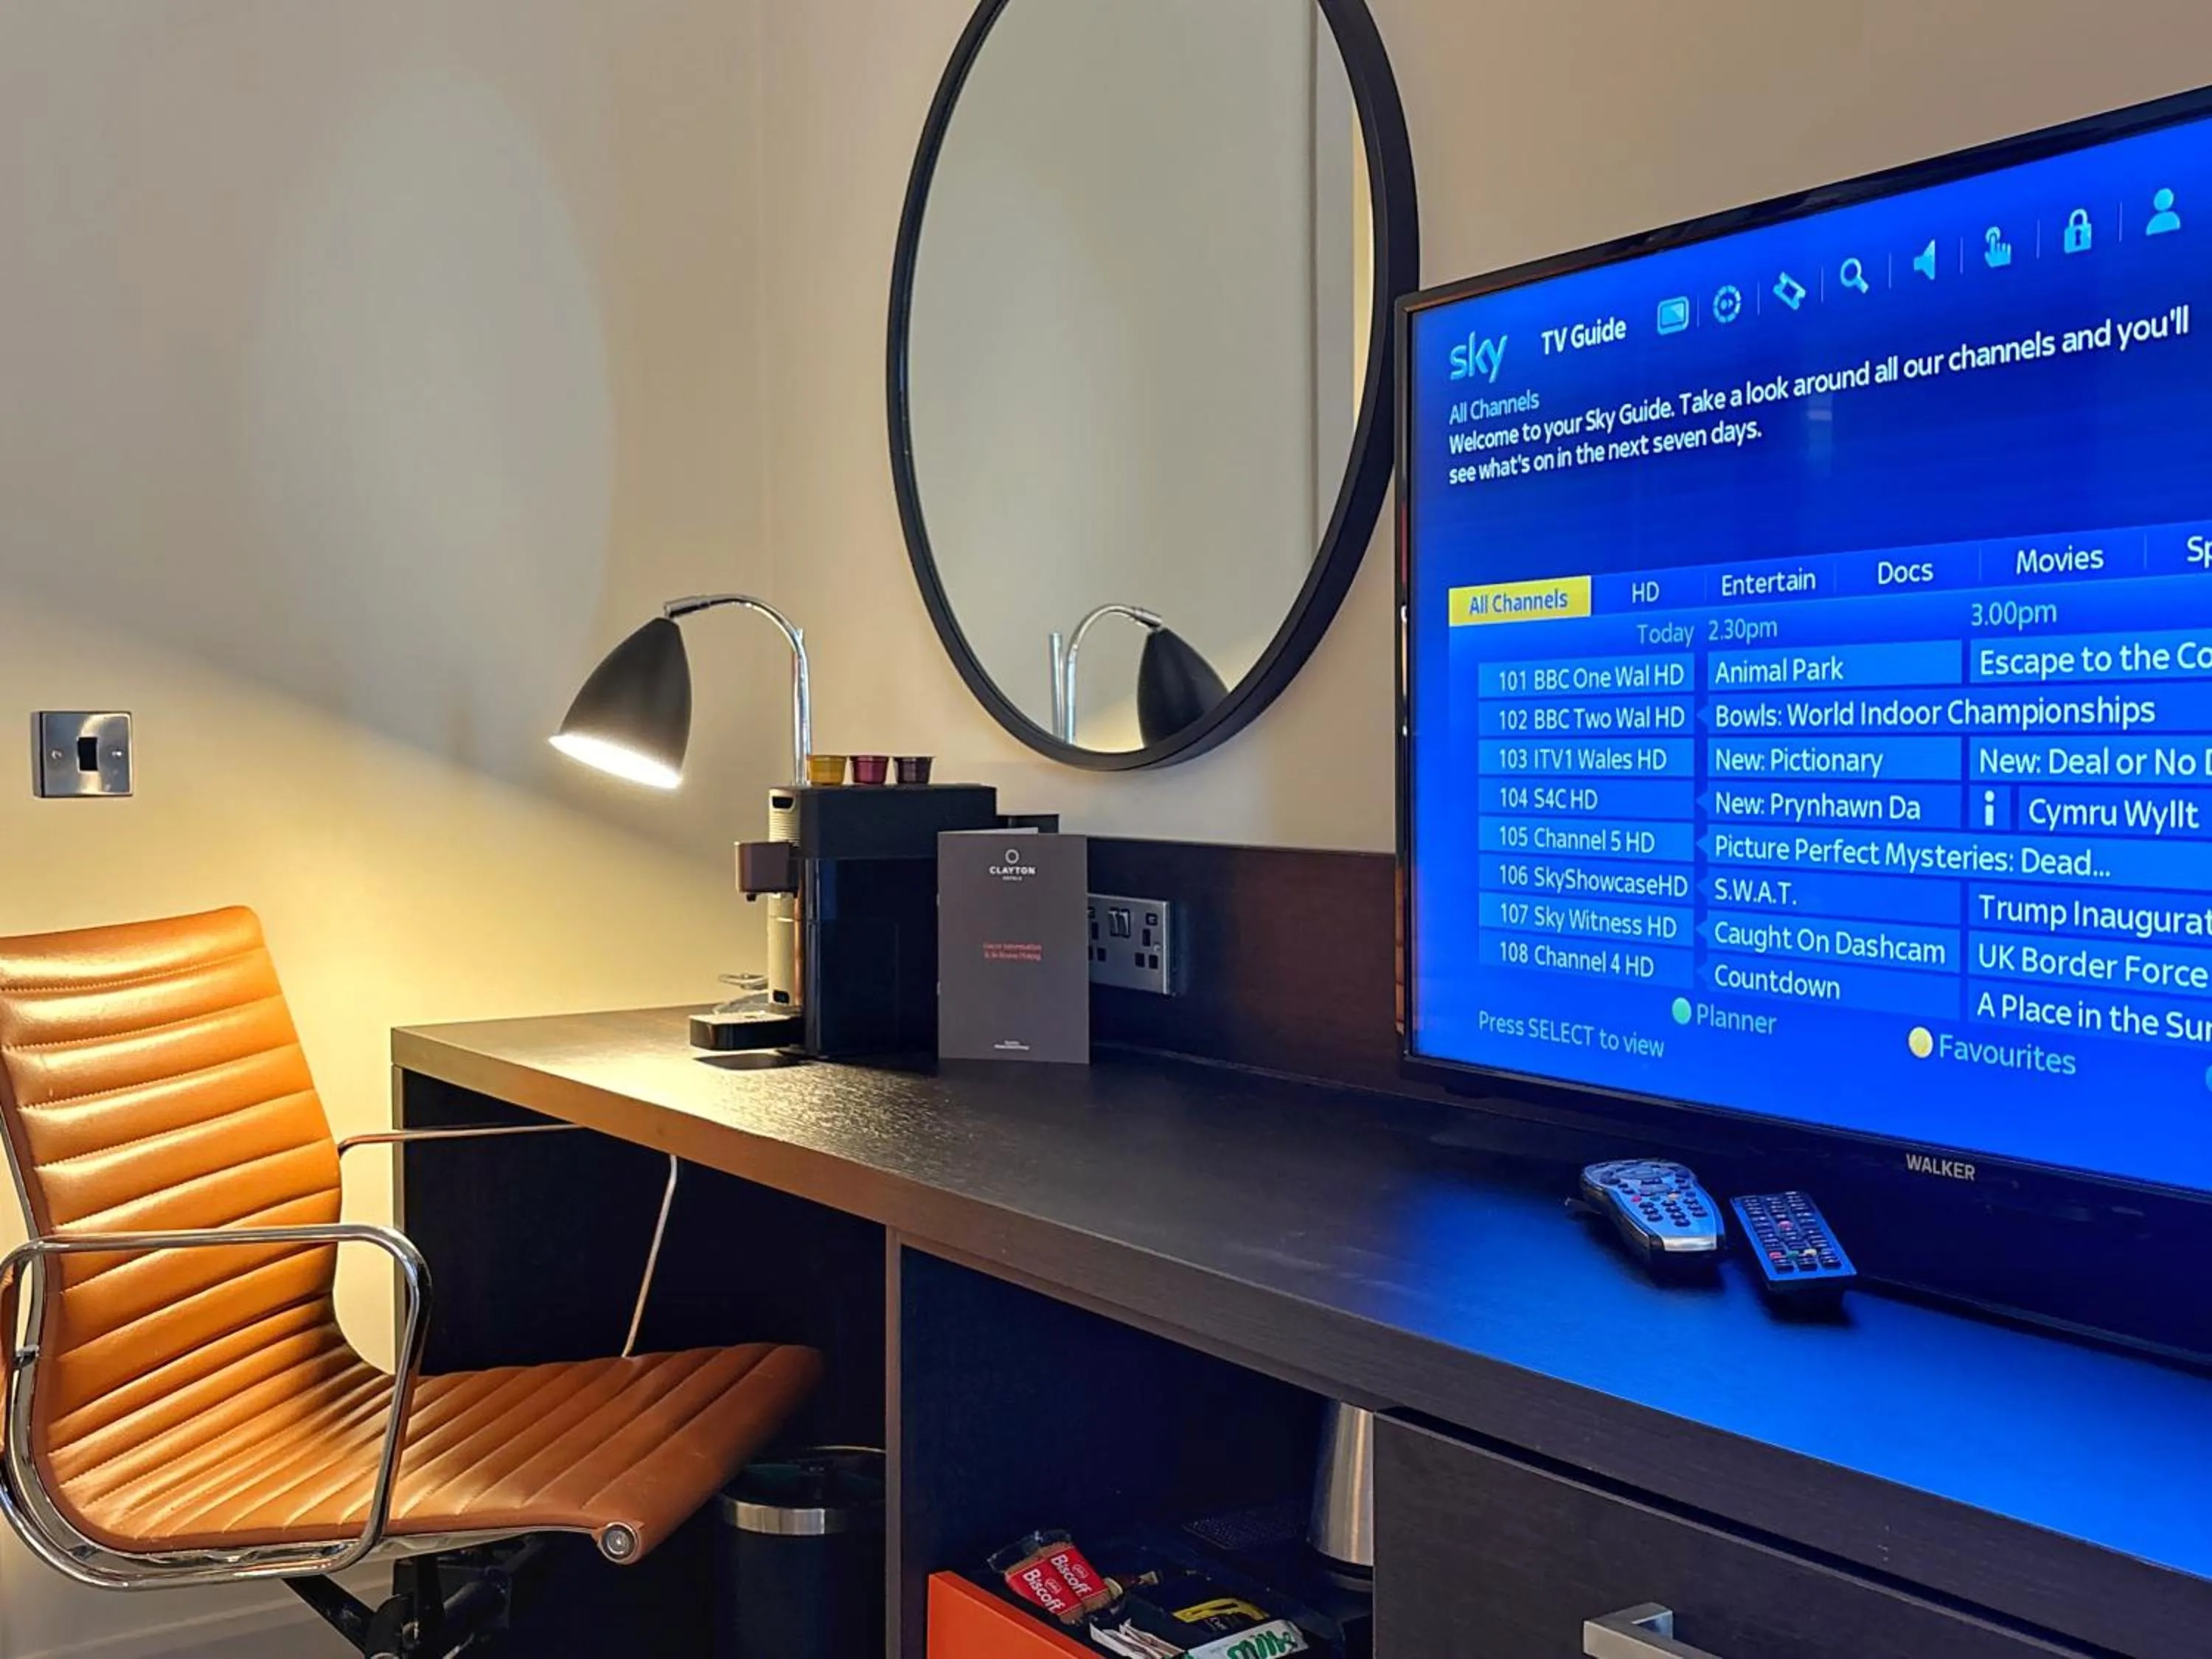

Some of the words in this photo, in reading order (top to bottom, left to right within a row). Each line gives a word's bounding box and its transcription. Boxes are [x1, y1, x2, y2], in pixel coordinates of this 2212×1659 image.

[1542, 330, 1568, 355] TV
[1571, 317, 1626, 349] Guide
[1450, 332, 1508, 383] sky
[1450, 431, 1519, 454] Welcome
[1523, 425, 1541, 442] to
[1544, 417, 1582, 443] your
[1586, 408, 1616, 433] Sky
[1619, 399, 1674, 426] Guide.
[1679, 386, 1725, 414] Take
[1730, 391, 1742, 407] a
[1745, 376, 1789, 404] look
[1794, 361, 1869, 397] around
[1874, 355, 1898, 382] all
[1904, 354, 1944, 378] our
[1949, 332, 2055, 370] channels
[2062, 319, 2111, 353] and
[2117, 305, 2189, 351] you'll
[1450, 402, 1468, 425] All
[1470, 389, 1539, 420] Channels
[1450, 462, 1475, 484] see
[1479, 451, 1530, 479] what's
[1534, 453, 1554, 470] on
[1557, 447, 1572, 467] in
[1576, 442, 1604, 465] the
[1608, 434, 1649, 460] next
[1653, 429, 1706, 454] seven
[1711, 417, 1761, 446] days.
[1878, 561, 1933, 585] Docs
[2017, 545, 2104, 574] Movies
[1632, 582, 1659, 603] HD
[1722, 568, 1815, 597] Entertain
[1470, 592, 1488, 614] All
[1492, 588, 1568, 613] Channels
[1971, 601, 2057, 632] 3.00pm
[1638, 624, 1694, 647] Today
[1708, 619, 1778, 645] 2.30pm
[1715, 658, 1787, 685] Animal
[1792, 655, 1843, 682] Park
[1980, 650, 2074, 681] Escape
[2082, 647, 2112, 672] to
[2120, 642, 2170, 671] the
[1499, 671, 1526, 692] 101
[1534, 669, 1569, 691] BBC
[1573, 668, 1611, 689] One
[1615, 664, 1649, 688] Wal
[1655, 664, 1684, 686] HD
[1499, 709, 1527, 731] 102
[1534, 708, 1569, 730] BBC
[1573, 708, 1612, 729] Two
[1615, 706, 1650, 728] Wal
[1655, 706, 1685, 728] HD
[1716, 703, 1781, 728] Bowls:
[1787, 700, 1854, 727] World
[1861, 699, 1942, 726] Indoor
[1947, 695, 2155, 731] Championships
[1499, 748, 1527, 769] 103
[1534, 748, 1573, 770] ITV1
[1577, 747, 1632, 771] Wales
[1638, 747, 1666, 771] HD
[1715, 748, 1765, 772] New:
[1770, 747, 1883, 779] Pictionary
[1980, 748, 2041, 775] New:
[2049, 746, 2109, 775] Deal
[2116, 754, 2147, 776] or
[2155, 748, 2196, 777] No
[1499, 787, 1528, 808] 104
[1534, 787, 1567, 809] S4C
[1571, 788, 1598, 810] HD
[1715, 792, 1765, 815] New:
[1770, 793, 1883, 822] Prynhawn
[1889, 795, 1921, 820] Da
[2029, 798, 2117, 831] Cymru
[2124, 799, 2199, 835] Wyllt
[1499, 826, 1528, 847] 105
[1534, 827, 1607, 851] Channel
[1611, 830, 1621, 851] 5
[1627, 831, 1655, 853] HD
[990, 866, 1035, 874] CLAYTON
[1716, 835, 1790, 860] Picture
[1795, 838, 1880, 866] Perfect
[1885, 841, 2014, 873] Mysteries:
[2022, 848, 2111, 877] Dead...
[1499, 865, 1528, 886] 106
[1715, 878, 1797, 905] S.W.A.T.
[1500, 903, 1528, 925] 107
[1534, 905, 1565, 931] Sky
[1568, 908, 1642, 936] Witness
[1648, 916, 1677, 939] HD
[1979, 894, 2066, 931] Trump
[2074, 900, 2212, 938] Inaugurat
[1715, 921, 1792, 953] Caught
[1797, 928, 1829, 953] On
[1836, 932, 1945, 964] Dashcam
[1500, 942, 1528, 964] 108
[1534, 945, 1607, 973] Channel
[1610, 952, 1621, 973] 4
[1626, 954, 1654, 978] HD
[1978, 944, 2015, 970] UK
[2022, 946, 2118, 980] Border
[2124, 956, 2208, 989] Force
[1715, 964, 1840, 1000] Countdown
[1697, 1004, 1777, 1036] Planner
[1978, 992, 1996, 1017] A
[2002, 994, 2072, 1026] Place
[2078, 1001, 2101, 1030] in
[2110, 1005, 2159, 1036] the
[1479, 1010, 1524, 1037] Press
[1528, 1018, 1595, 1047] SELECT
[1599, 1029, 1619, 1050] to
[1624, 1033, 1664, 1058] view
[1939, 1034, 2076, 1075] Favourites
[1906, 1153, 1975, 1180] WALKER
[1022, 1568, 1065, 1613] Biscoff
[1051, 1554, 1092, 1597] Biscoff
